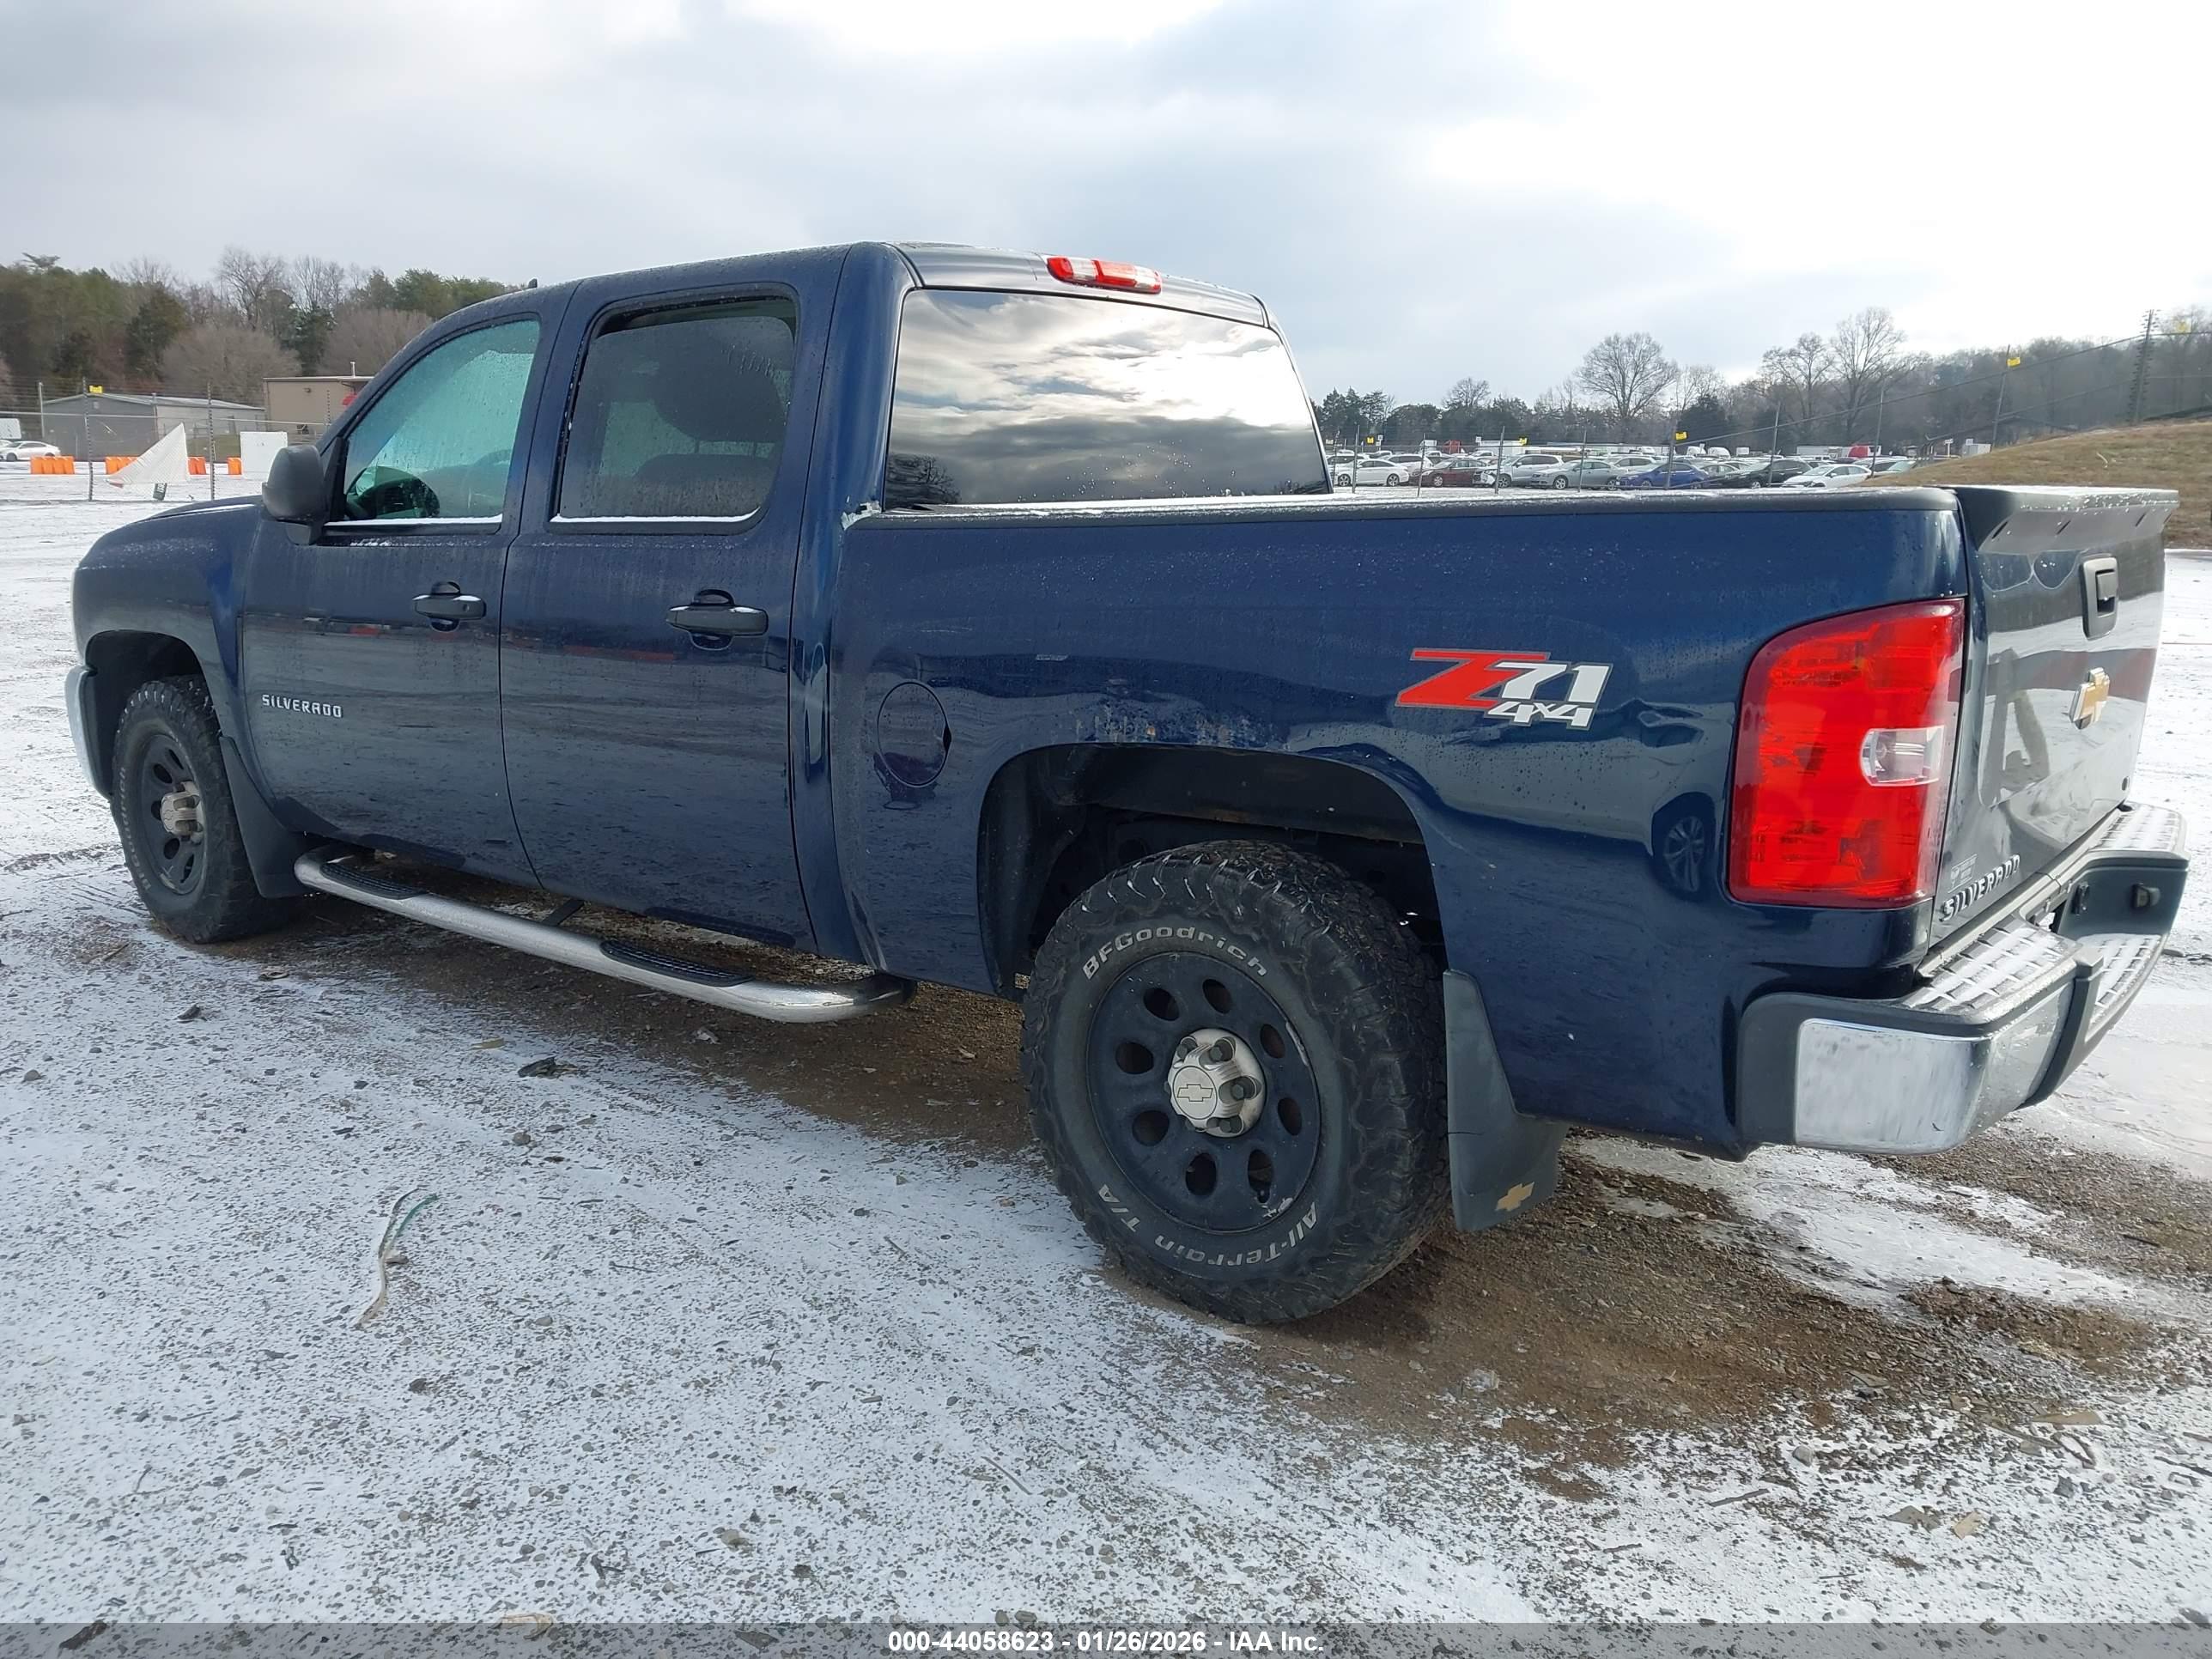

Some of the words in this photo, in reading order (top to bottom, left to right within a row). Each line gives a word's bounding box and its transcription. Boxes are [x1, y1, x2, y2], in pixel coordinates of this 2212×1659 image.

[261, 694, 343, 718] SILVERADO
[1395, 648, 1613, 709] Z71
[1941, 854, 2021, 921] SILVERADO
[1081, 927, 1268, 980] BFGoodrich
[1097, 1184, 1141, 1232] T/A
[1154, 1201, 1318, 1267] All-Terrain
